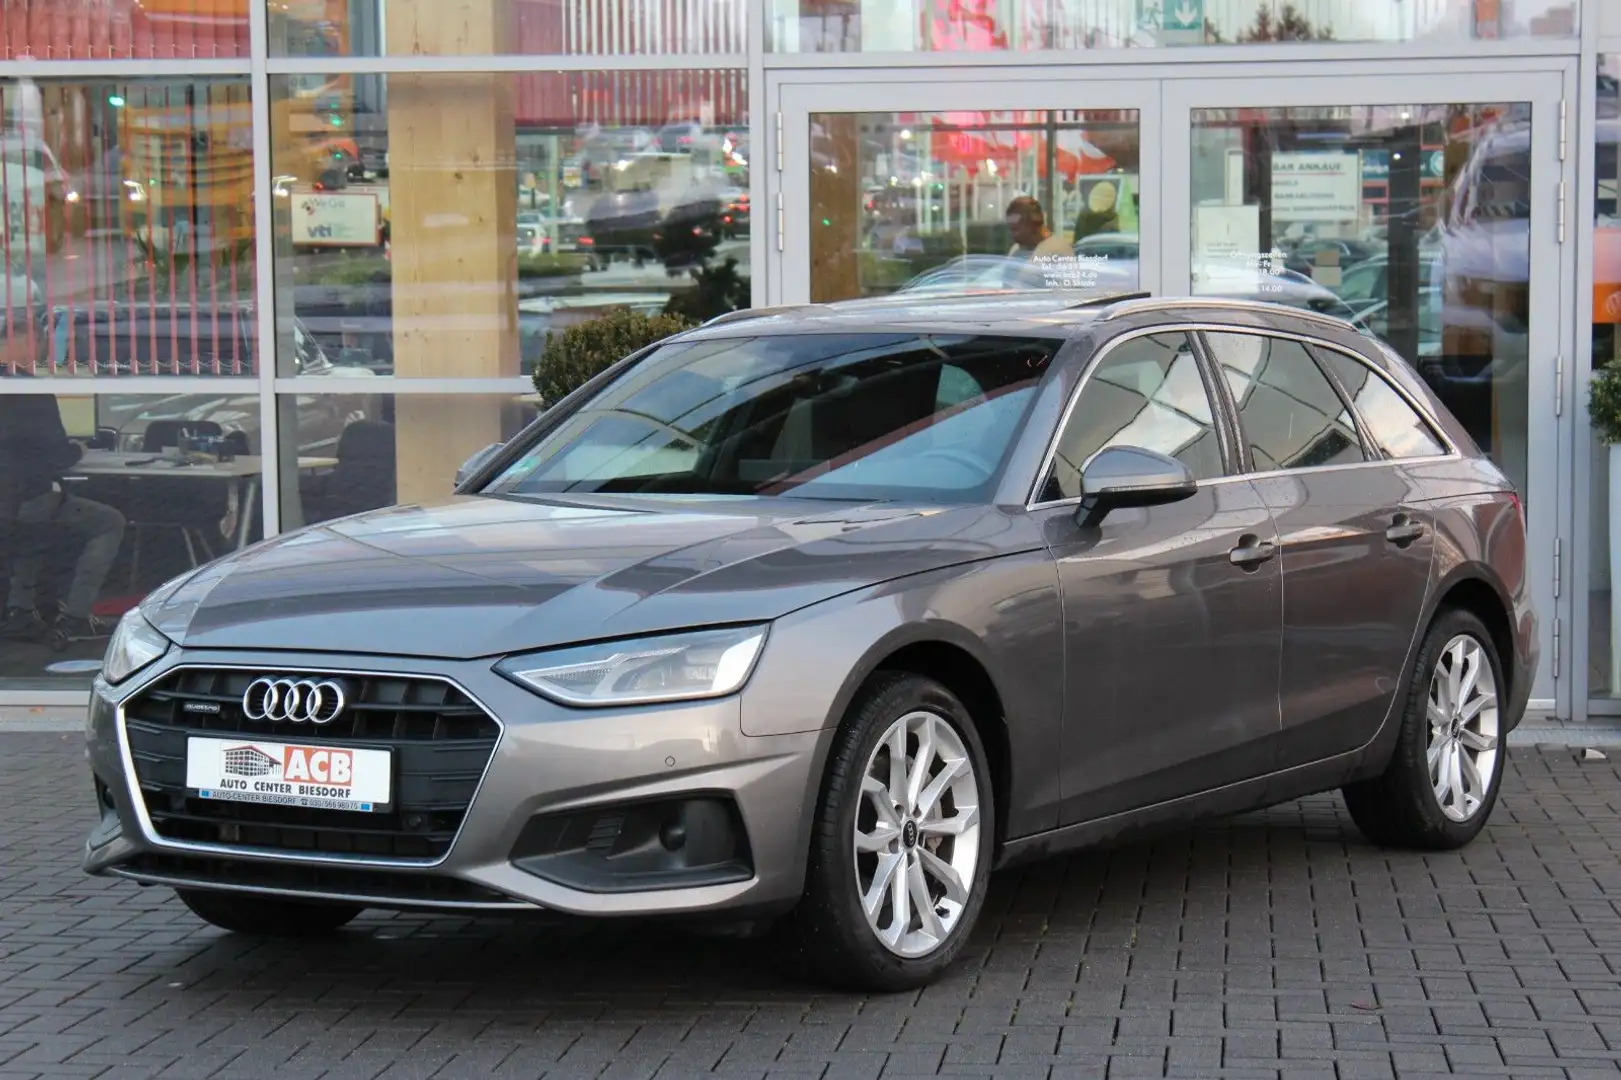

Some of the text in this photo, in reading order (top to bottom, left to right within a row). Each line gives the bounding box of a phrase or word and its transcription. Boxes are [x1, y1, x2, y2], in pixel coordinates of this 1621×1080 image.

[1052, 254, 1077, 262] Center
[1261, 284, 1283, 292] 14.00
[285, 747, 351, 783] ACB
[220, 778, 351, 798] AUTO CENTER BIESDORF
[262, 795, 297, 804] BIESDORF
